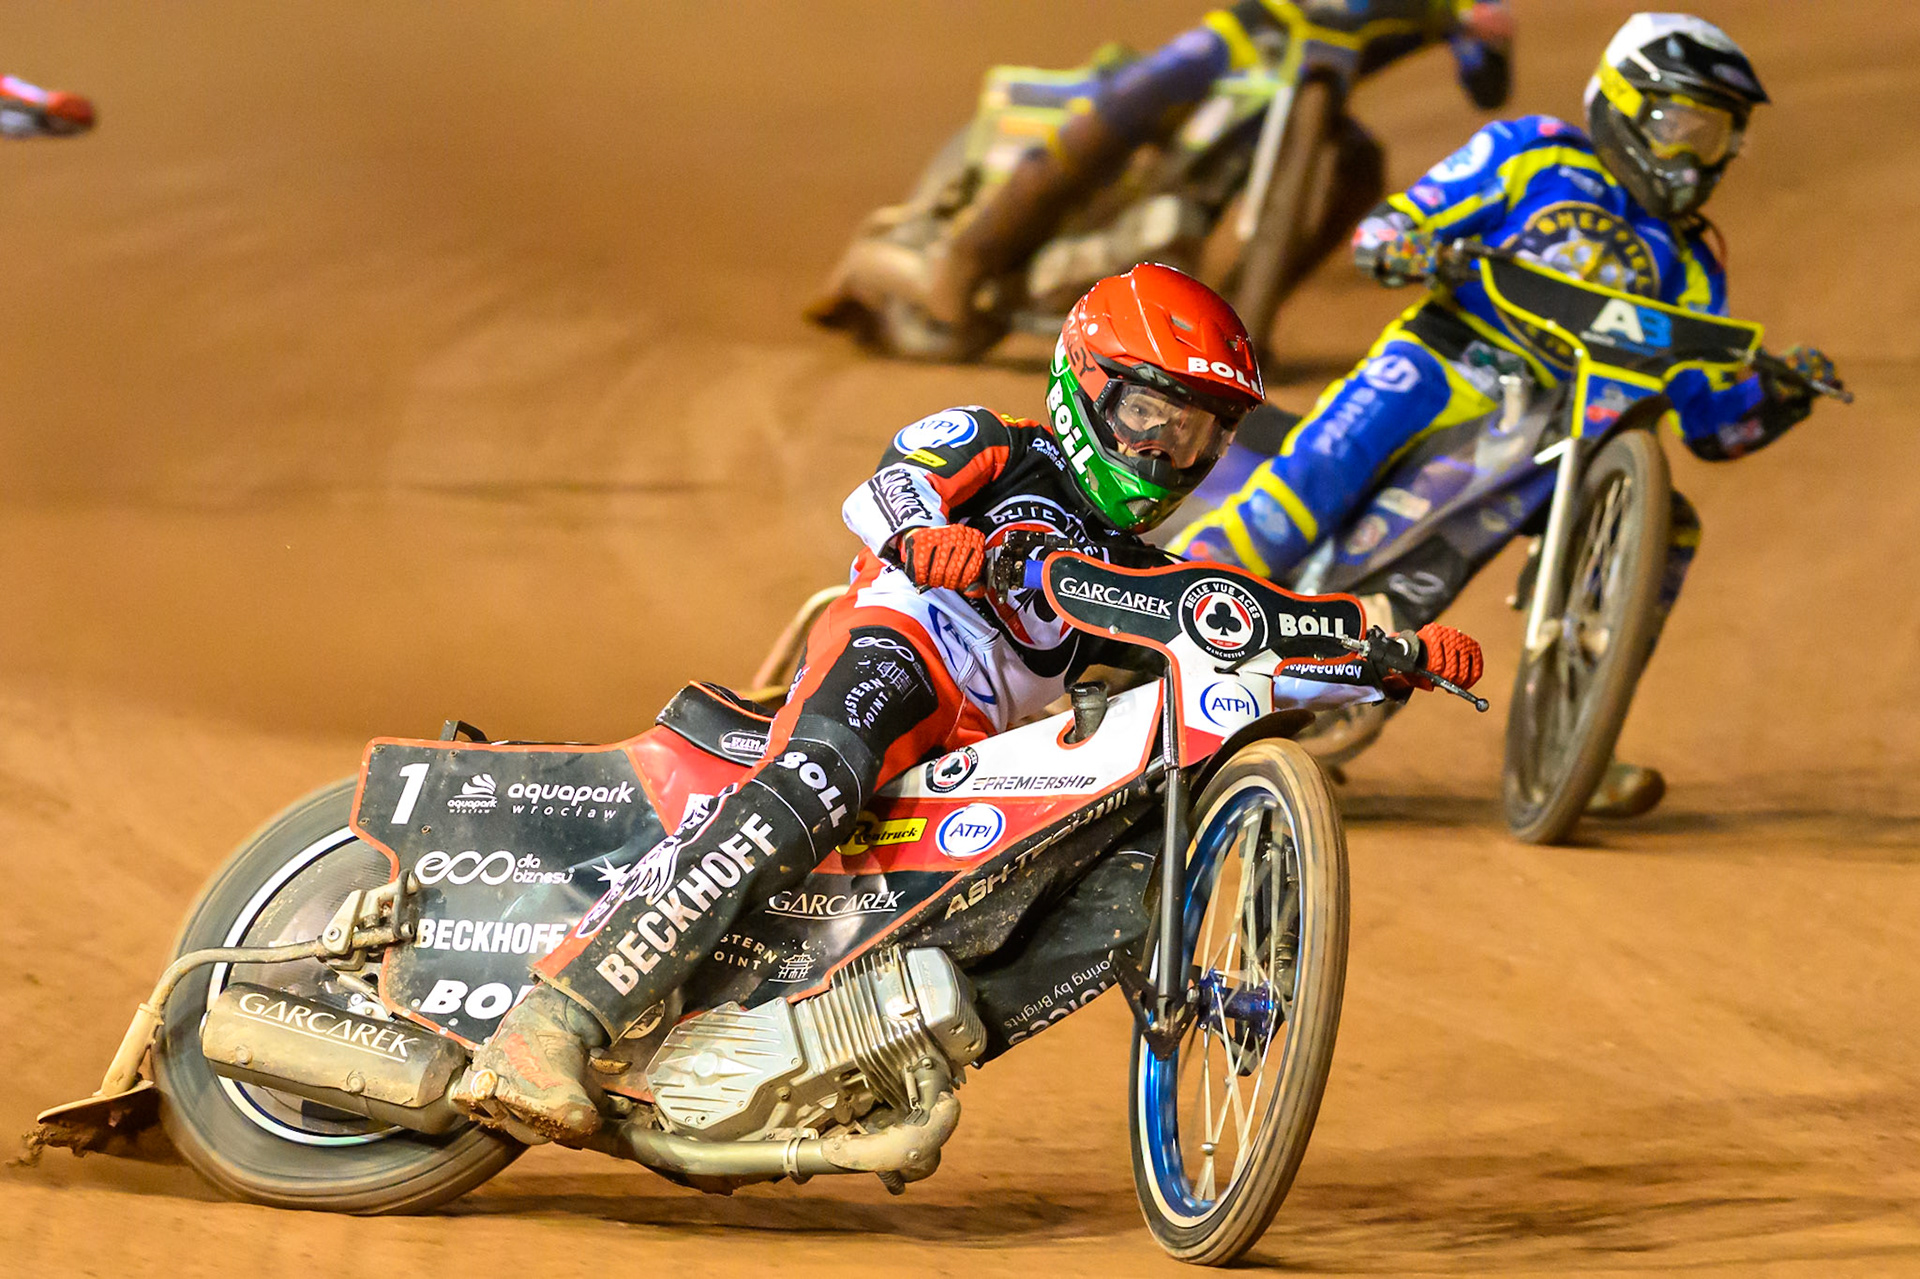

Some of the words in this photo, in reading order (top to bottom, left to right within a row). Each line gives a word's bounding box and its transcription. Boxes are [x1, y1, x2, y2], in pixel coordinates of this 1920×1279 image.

[1188, 357, 1264, 396] BOLL
[1048, 379, 1097, 476] BOLL
[1059, 577, 1173, 618] GARCAREK
[1184, 584, 1210, 609] BELLE
[1212, 583, 1236, 596] VUE
[1237, 594, 1261, 619] ACES
[1278, 612, 1348, 639] BOLL
[1205, 646, 1246, 659] MANCHESTER
[844, 677, 886, 729] EASTERN
[863, 690, 890, 730] POINT
[1210, 697, 1251, 719] ATPI
[390, 763, 430, 825] 1
[447, 799, 498, 809] aquapark
[507, 781, 635, 807] aquapark
[775, 751, 848, 828] BOLL
[512, 803, 617, 819] wrocław
[949, 822, 993, 839] ATPI
[415, 850, 516, 886] eco
[513, 866, 576, 885] biznesu
[516, 853, 541, 868] dla
[595, 813, 777, 996] BECKHOFF
[768, 890, 906, 916] GARCAREK
[414, 918, 568, 955] BECKHOFF
[713, 950, 762, 971] OINT
[1071, 956, 1113, 987] oring
[1053, 981, 1074, 999] by
[238, 992, 420, 1058] GARCAREK
[1003, 995, 1054, 1029] Brights
